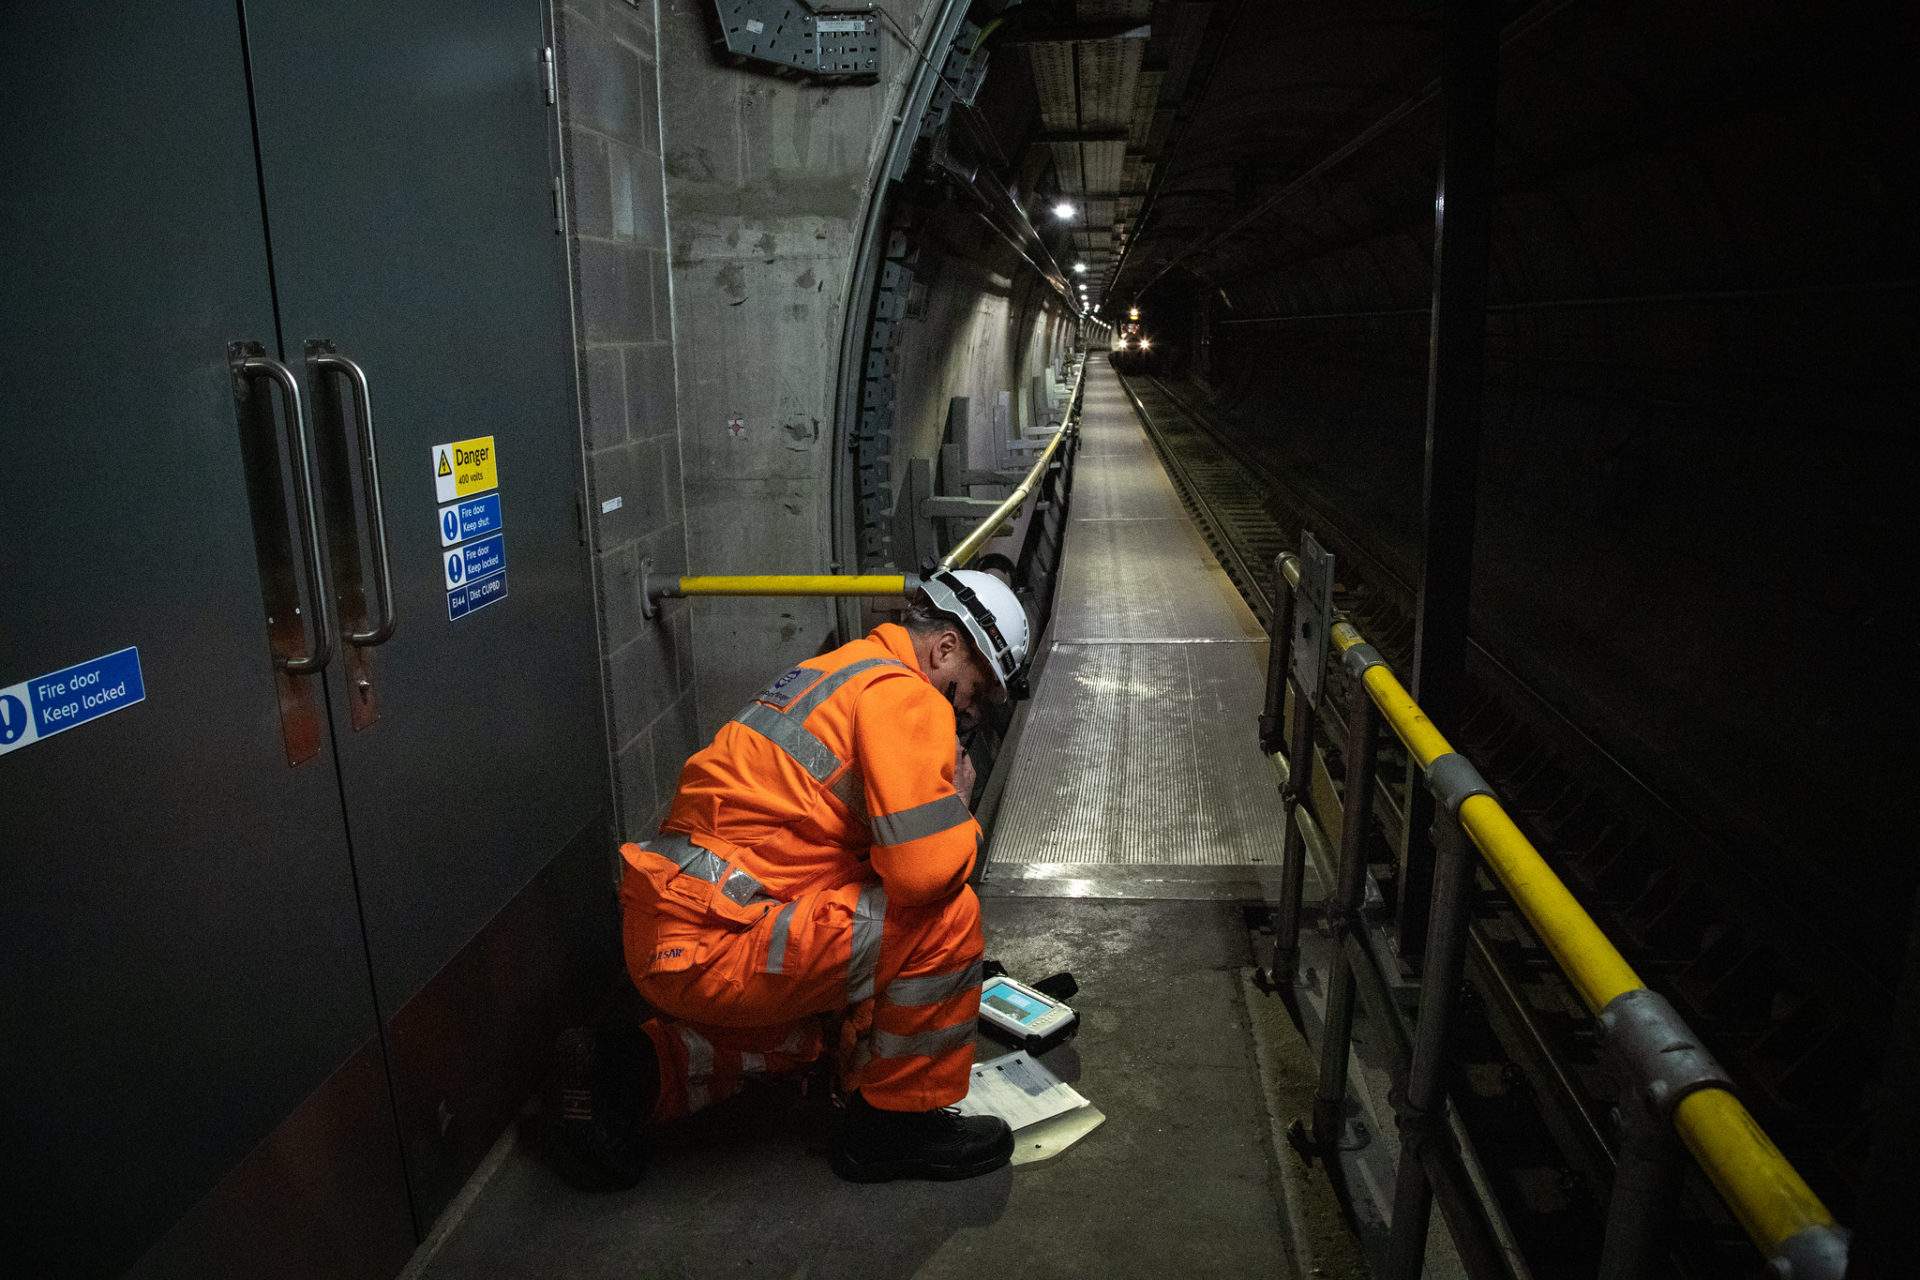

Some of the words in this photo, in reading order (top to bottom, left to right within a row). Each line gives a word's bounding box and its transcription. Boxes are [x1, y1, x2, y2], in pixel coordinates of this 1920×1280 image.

[456, 448, 489, 466] Danger
[459, 474, 470, 484] 400
[471, 472, 484, 482] volts
[461, 508, 473, 518] Fire
[473, 505, 486, 515] door
[463, 522, 477, 532] Keep
[477, 517, 490, 528] shut
[466, 549, 477, 560] Fire
[477, 546, 490, 556] door
[467, 563, 481, 574] Keep
[481, 555, 499, 569] locked
[469, 589, 481, 601] Dist
[38, 682, 66, 702] Fire
[69, 670, 101, 691] door
[42, 701, 79, 724] Keep
[81, 680, 126, 710] locked
